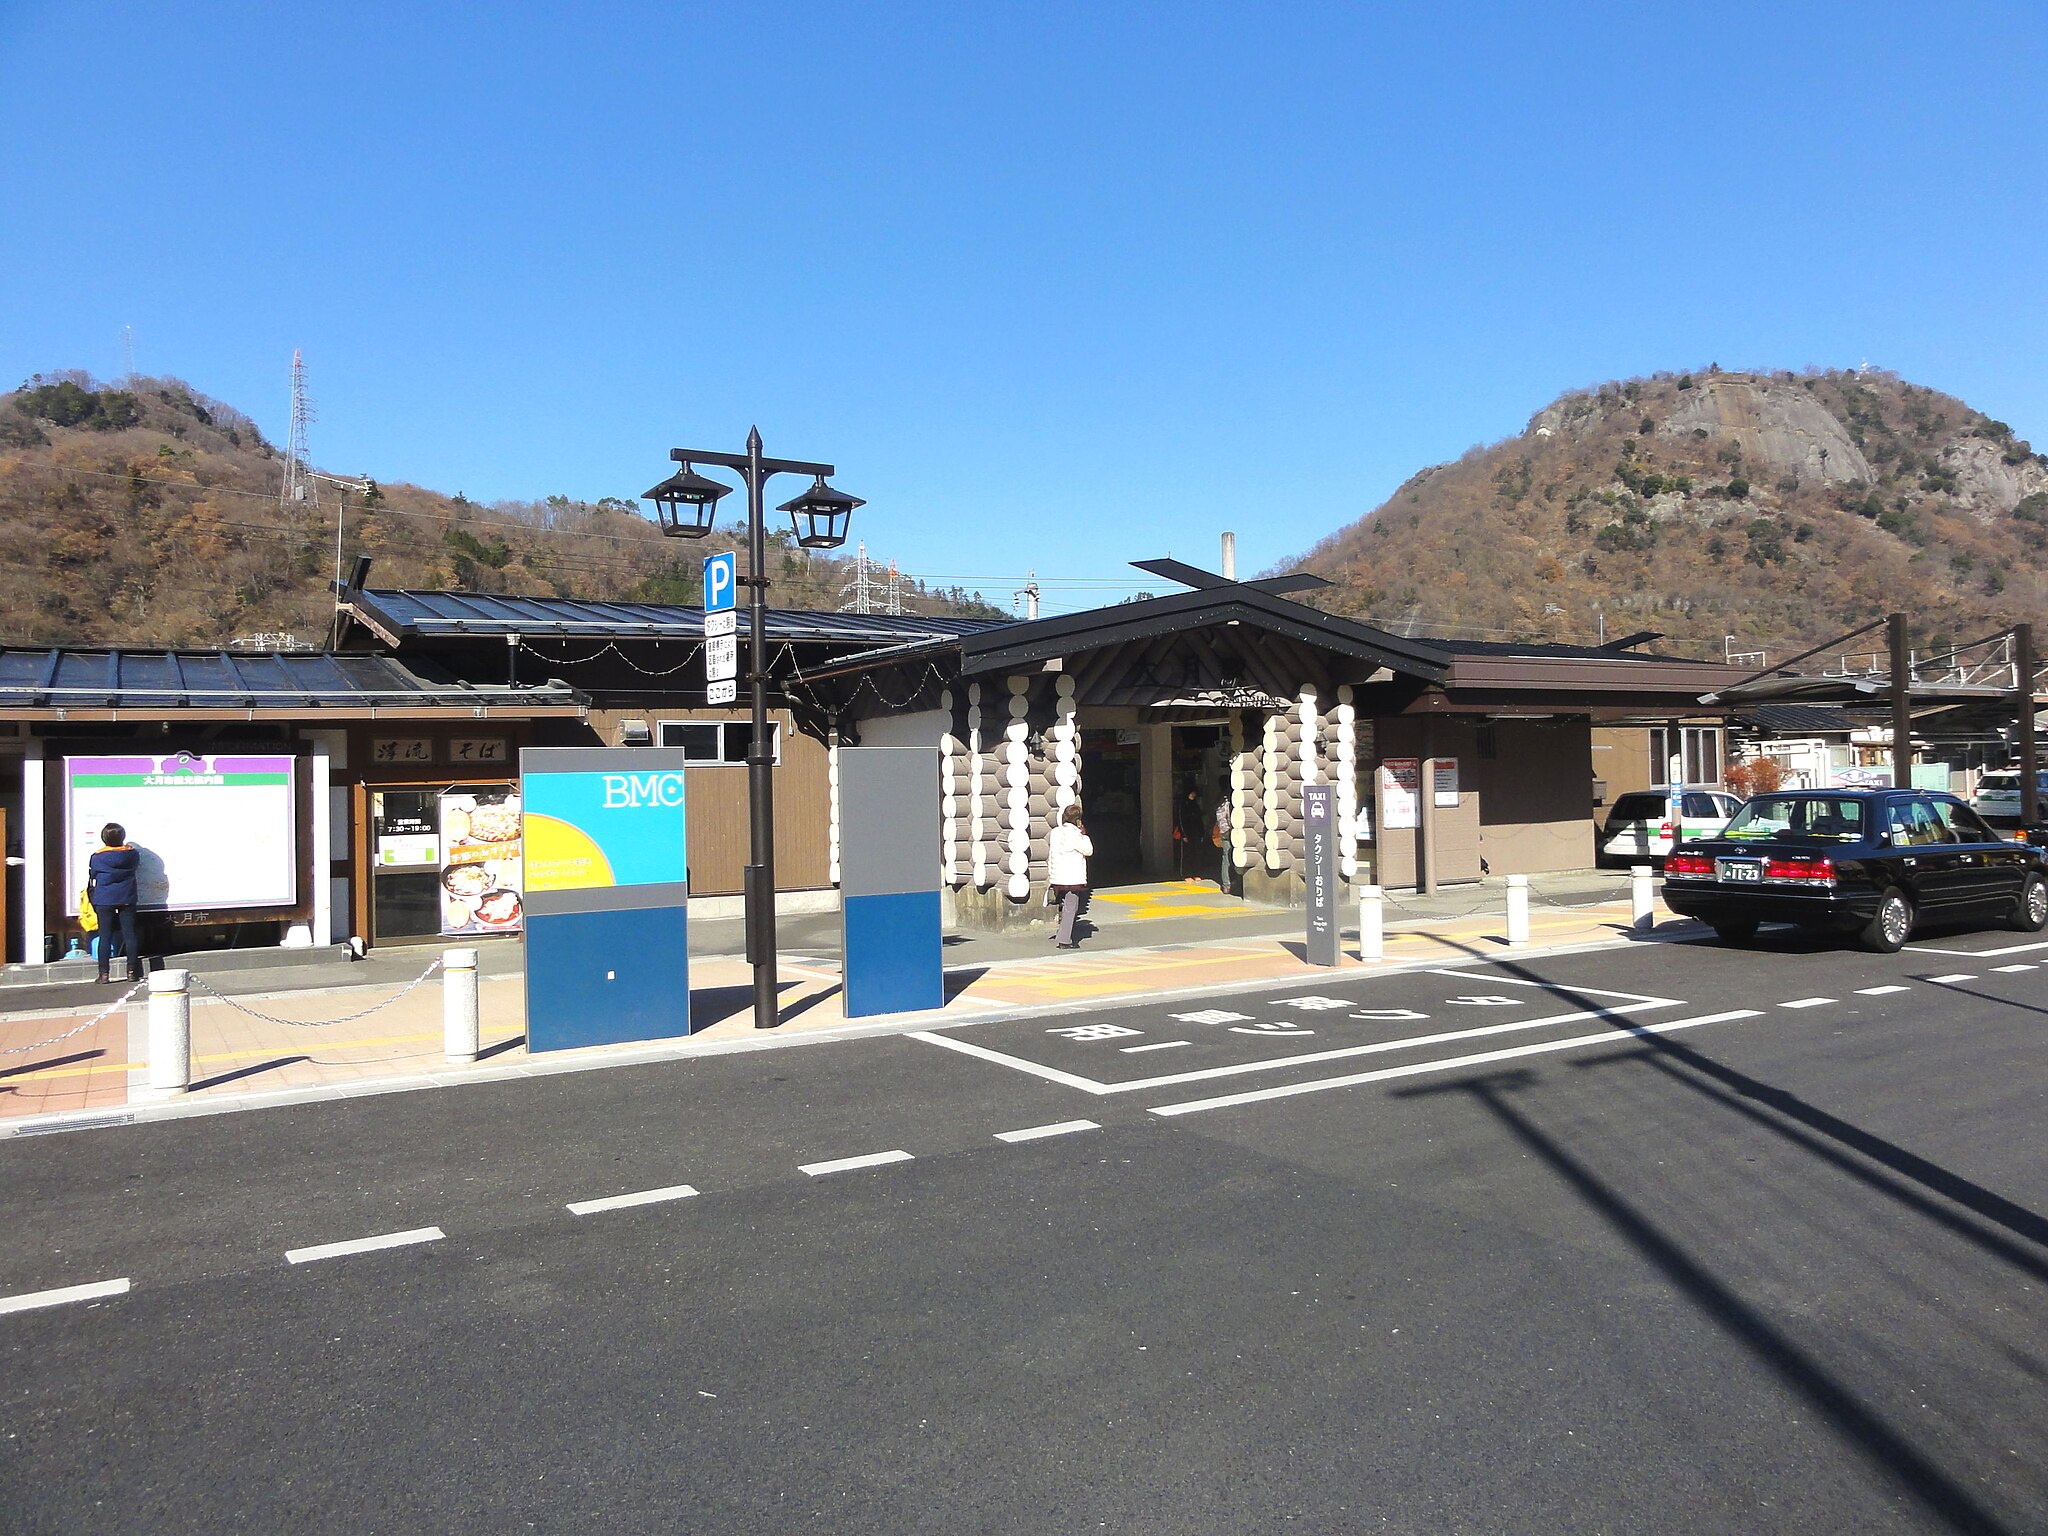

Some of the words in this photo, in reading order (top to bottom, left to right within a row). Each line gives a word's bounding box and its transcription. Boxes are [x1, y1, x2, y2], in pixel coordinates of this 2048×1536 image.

[711, 559, 730, 606] P
[708, 685, 735, 701] ここから
[459, 741, 501, 760] そば
[601, 773, 684, 809] BMC
[1308, 792, 1326, 801] TAXI
[1314, 833, 1325, 908] タクシーおりば
[164, 911, 210, 924] 大月市
